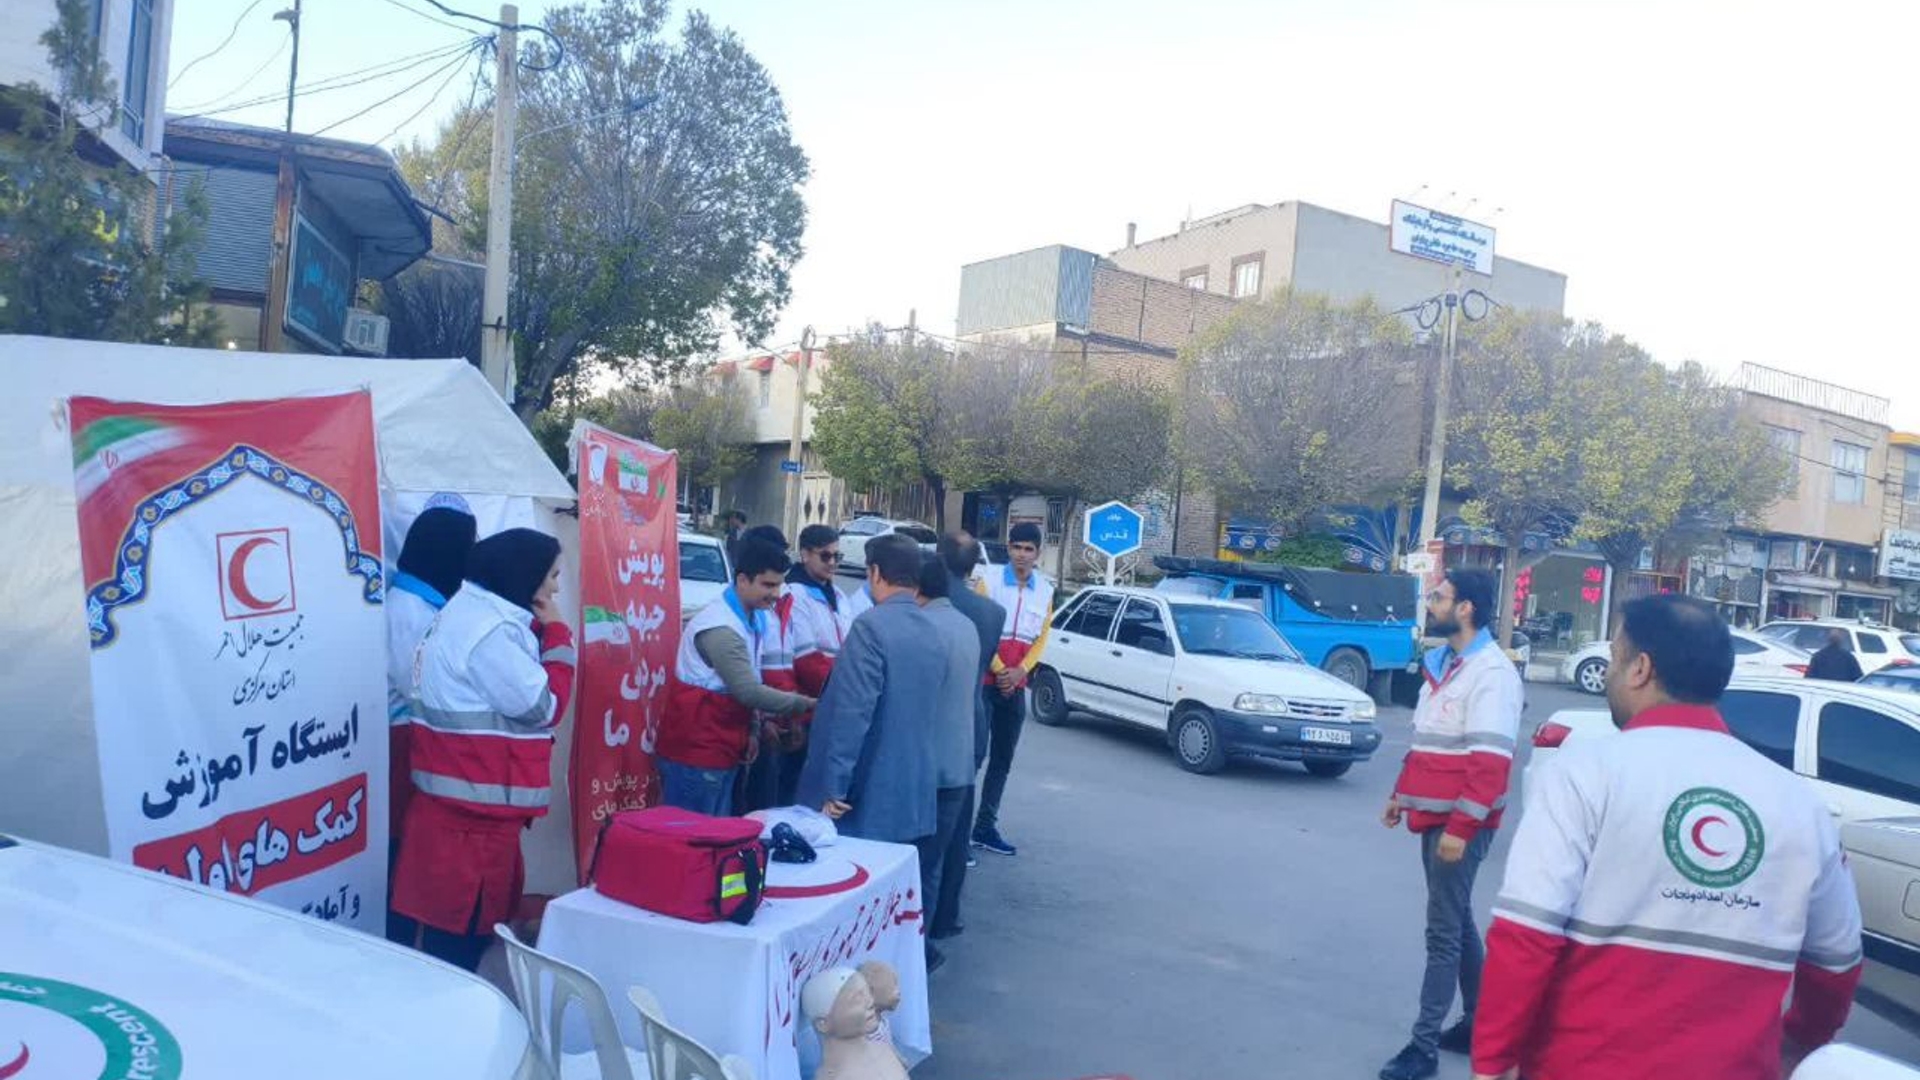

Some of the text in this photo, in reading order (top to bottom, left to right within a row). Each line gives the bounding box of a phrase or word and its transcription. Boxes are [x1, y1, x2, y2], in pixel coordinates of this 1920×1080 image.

[1099, 528, 1129, 541] قدس
[618, 537, 665, 592] پویش
[214, 613, 304, 661] جمعیت هلال احمر
[232, 649, 297, 706] استان مرکزی
[604, 708, 630, 747] ما
[142, 702, 359, 820] ایستگاه آموزش
[592, 778, 600, 794] و
[592, 799, 618, 821] های
[297, 784, 365, 854] کمک
[236, 817, 291, 892] های
[350, 893, 361, 920] و
[1724, 893, 1761, 910] سازمان
[87, 1002, 160, 1080] rescent
